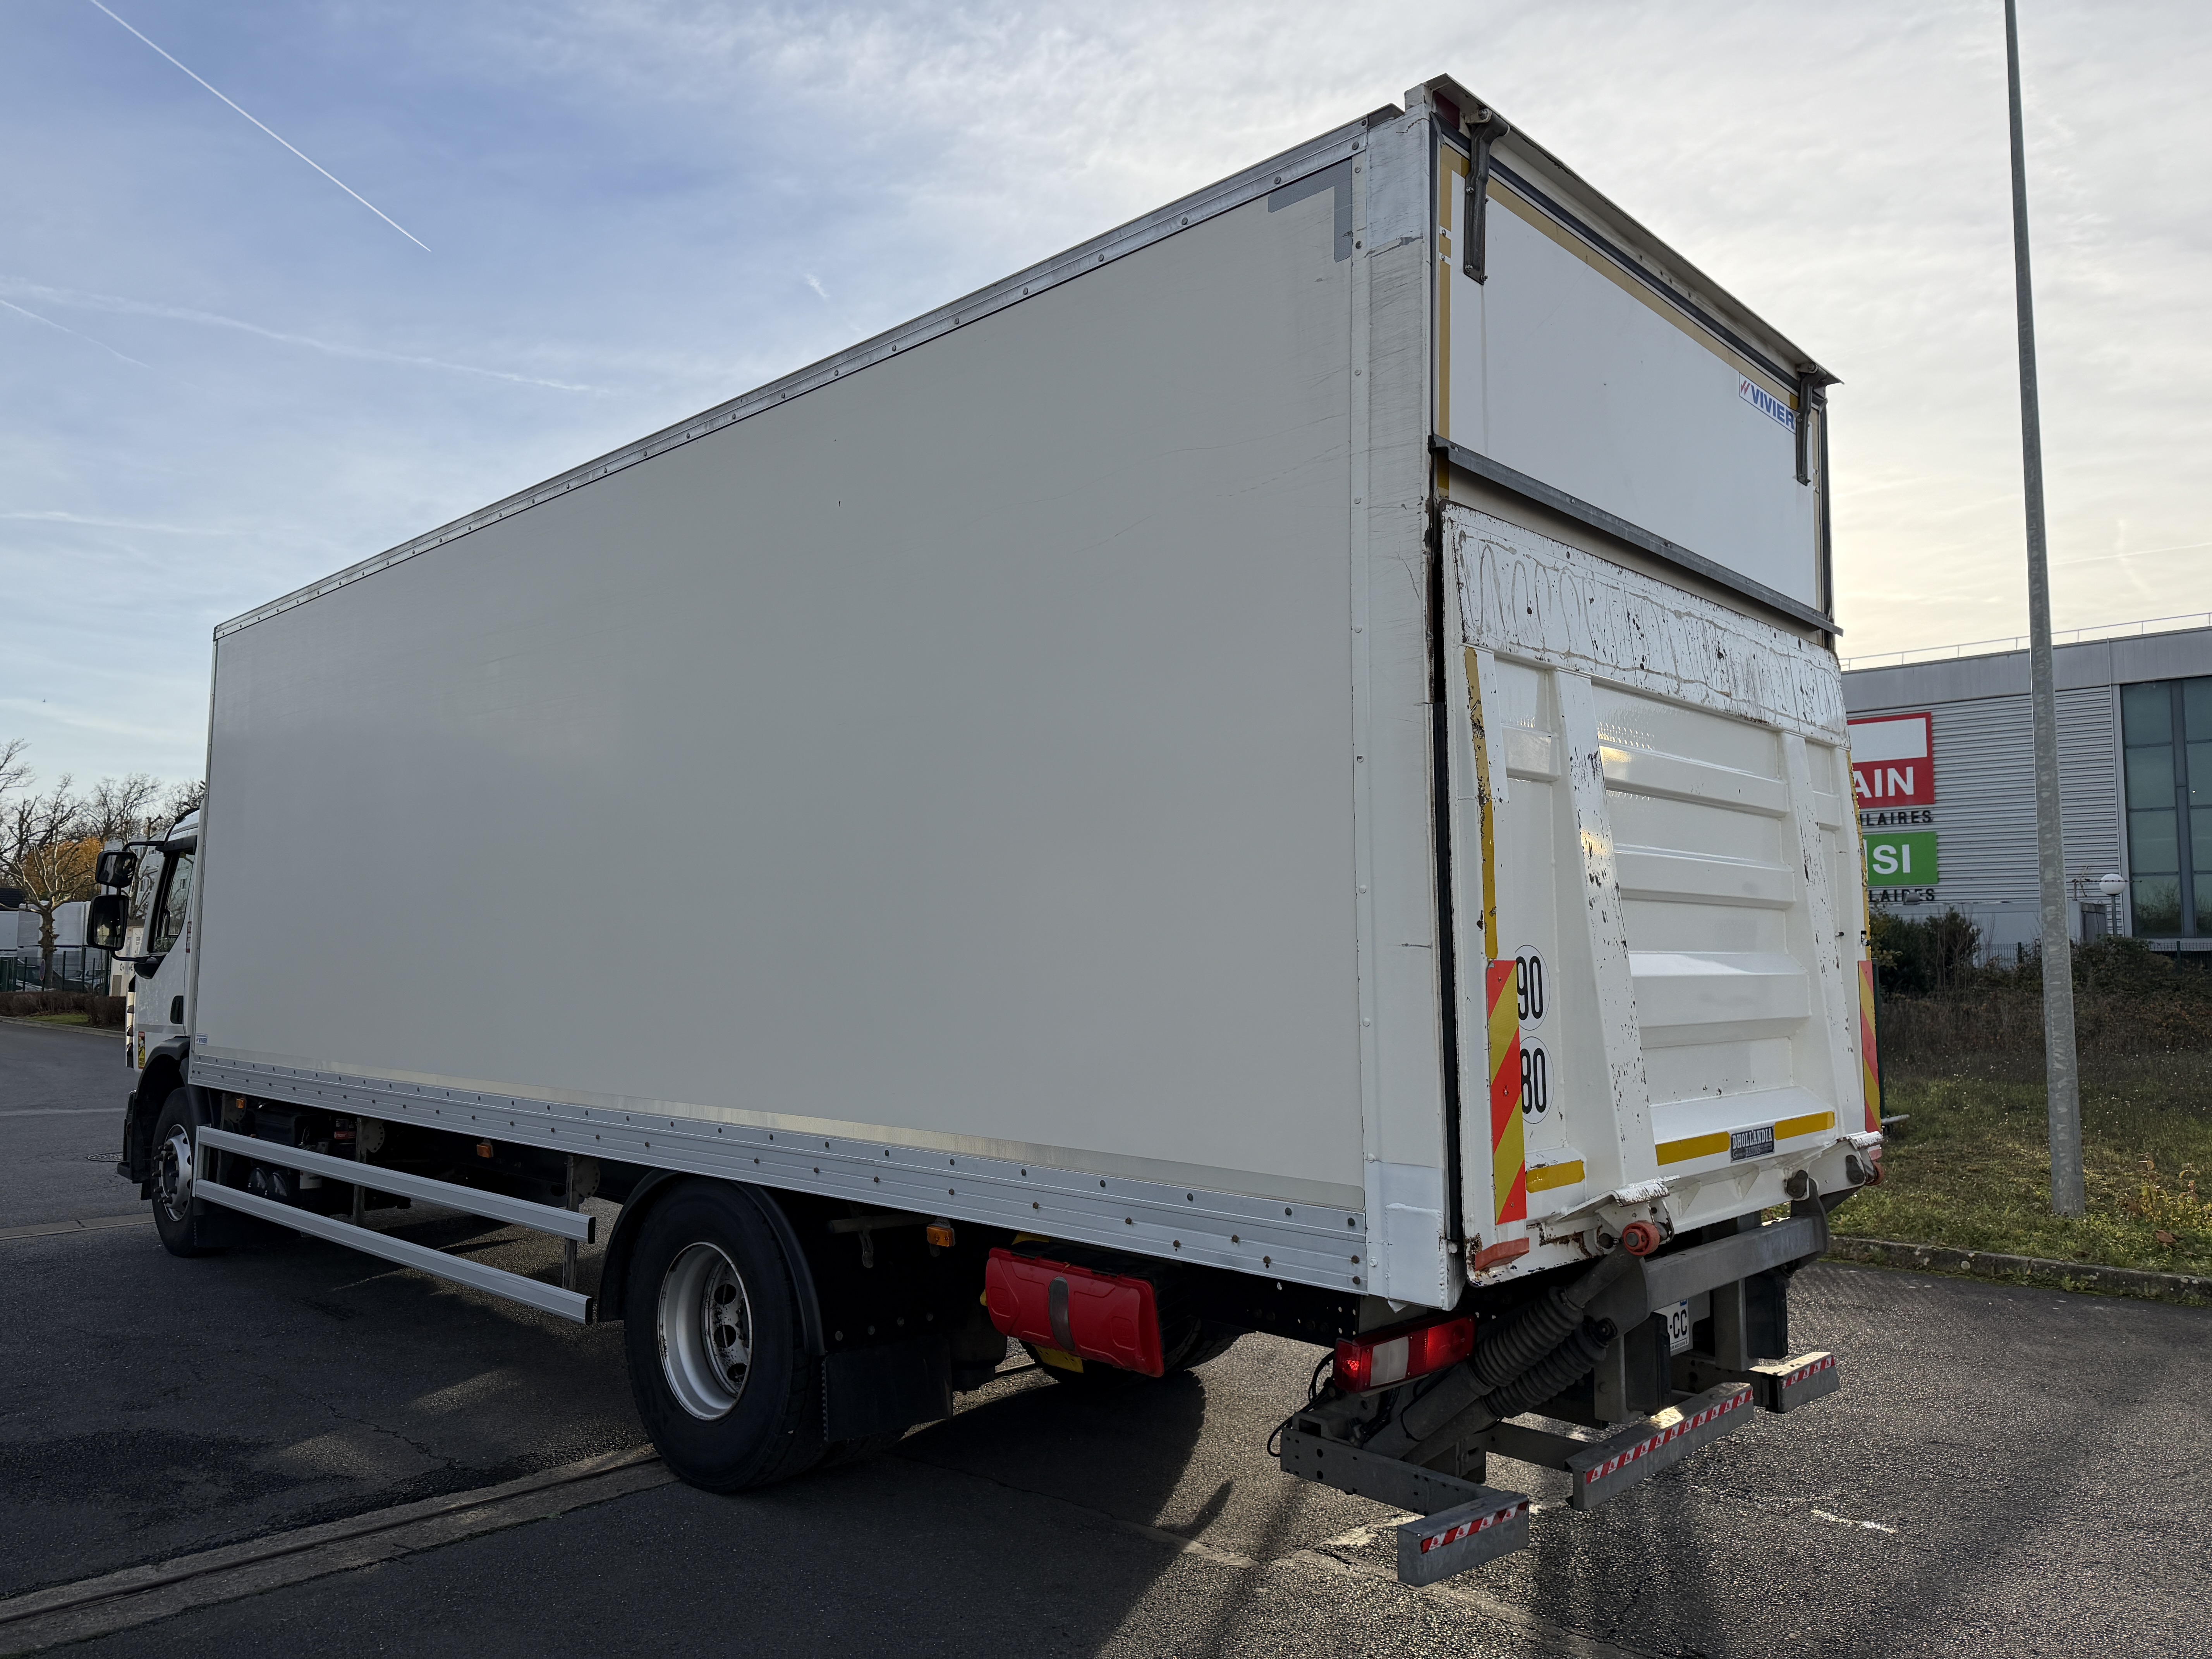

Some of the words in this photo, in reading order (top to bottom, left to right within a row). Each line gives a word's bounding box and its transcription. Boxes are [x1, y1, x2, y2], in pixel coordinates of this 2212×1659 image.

[1751, 384, 1795, 430] VIVIER
[1853, 766, 1914, 798] AIN
[1860, 810, 1931, 826] LAIRES
[1516, 956, 1543, 1020] 90
[1520, 1048, 1547, 1114] 80
